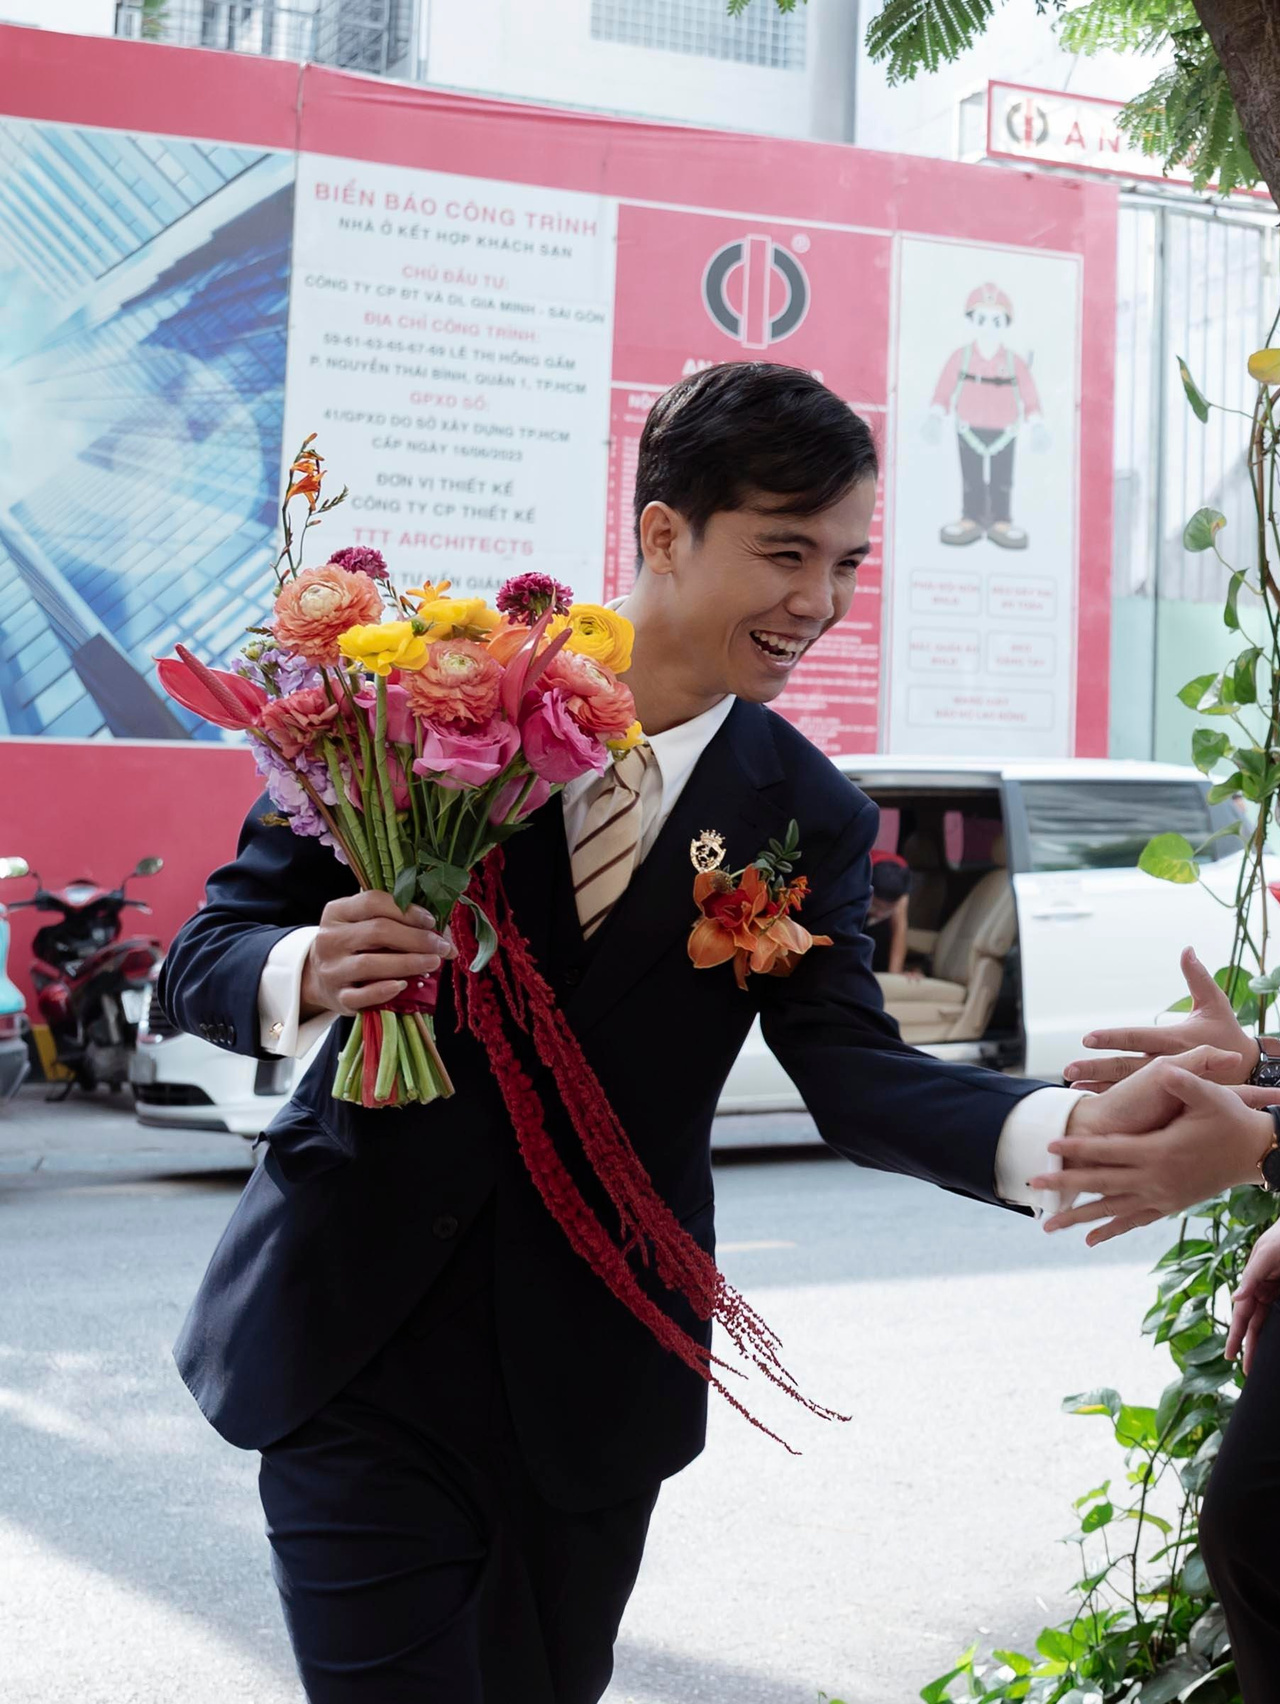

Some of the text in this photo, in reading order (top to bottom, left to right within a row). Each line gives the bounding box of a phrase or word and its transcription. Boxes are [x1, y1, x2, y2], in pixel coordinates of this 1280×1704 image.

[385, 191, 437, 216] BÁO
[445, 200, 515, 227] CÔNG
[525, 211, 598, 237] TRÌNH
[476, 235, 535, 254] KHÁCH
[304, 274, 349, 292] CÔNG
[354, 281, 371, 294] TY
[376, 284, 397, 297] CP
[431, 317, 480, 337] CÔNG
[390, 412, 413, 429] DO
[350, 494, 401, 514] CÔNG
[406, 499, 428, 515] TY
[432, 501, 456, 518] CP
[352, 526, 534, 557] TTT ARCHITECTS
